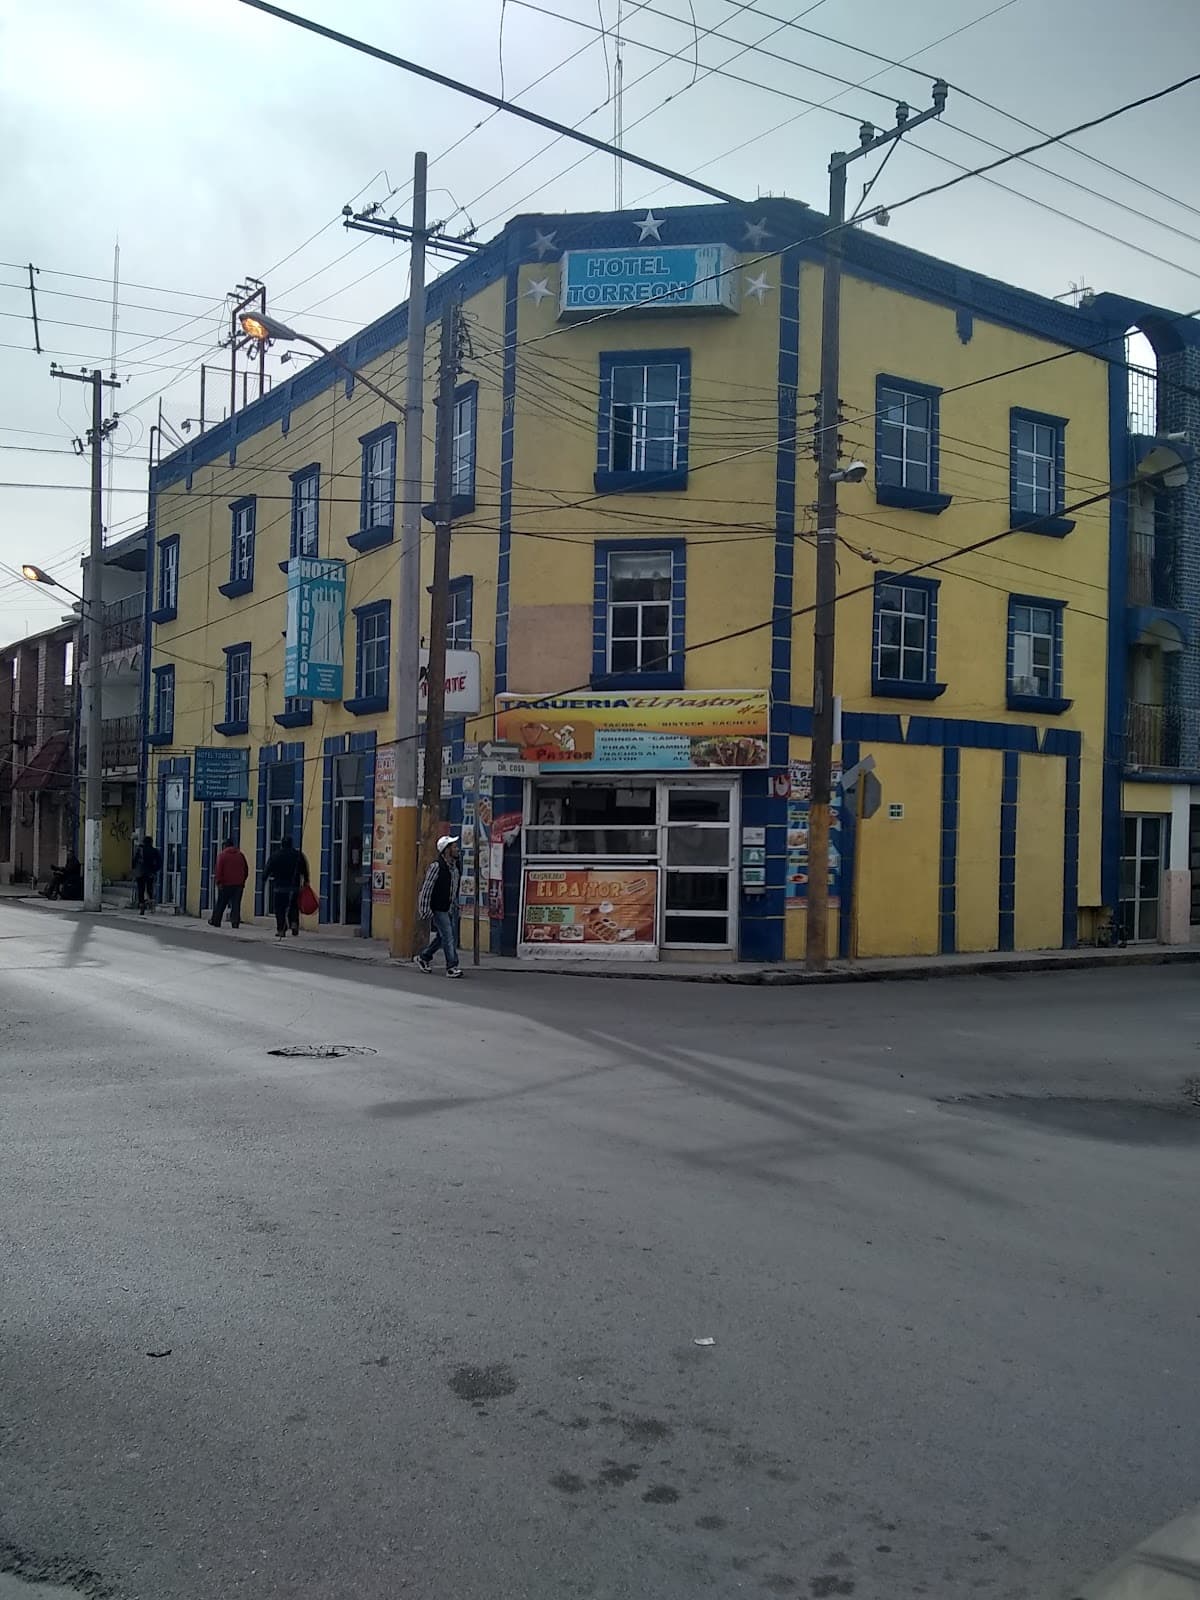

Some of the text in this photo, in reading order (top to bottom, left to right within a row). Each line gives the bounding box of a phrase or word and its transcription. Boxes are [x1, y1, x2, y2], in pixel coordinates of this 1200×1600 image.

[587, 257, 671, 279] HOTEL
[568, 281, 689, 304] TORREON
[301, 560, 346, 583] HOTEL
[299, 584, 311, 691] TORREON
[419, 676, 467, 699] TATE
[500, 698, 628, 710] TAQUERIA
[737, 704, 768, 714] #2
[536, 748, 594, 761] PASTOR
[509, 763, 525, 772] COSS
[536, 880, 623, 898] EL PASTOR
